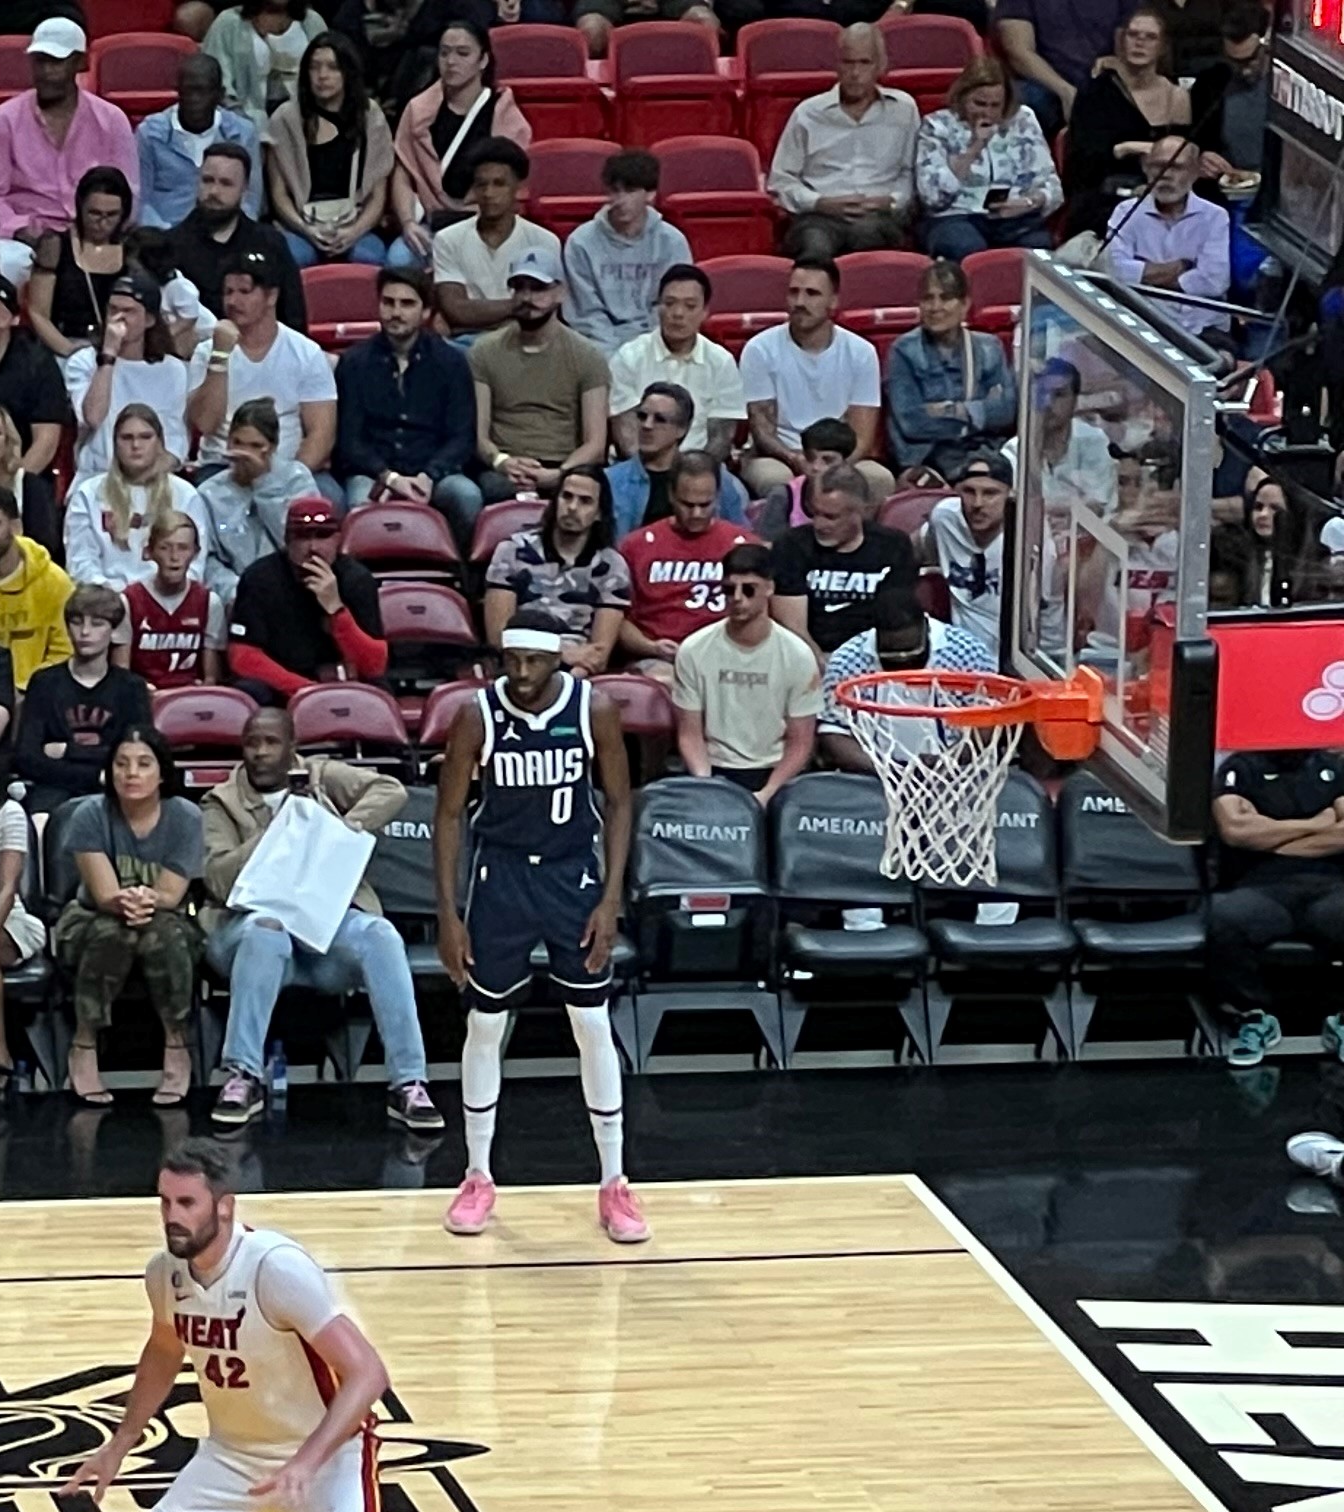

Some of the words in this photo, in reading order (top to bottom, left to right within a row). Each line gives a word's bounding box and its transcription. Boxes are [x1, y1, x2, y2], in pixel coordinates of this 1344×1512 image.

[649, 561, 724, 583] MIAM
[808, 566, 891, 593] HEAT
[685, 584, 726, 612] 33
[139, 633, 201, 650] MIAMI
[168, 652, 198, 672] 14
[719, 669, 768, 688] Kappa
[551, 787, 574, 825] 0
[652, 822, 750, 842] AMERANT
[174, 1305, 247, 1351] HEAT
[204, 1354, 250, 1388] 42
